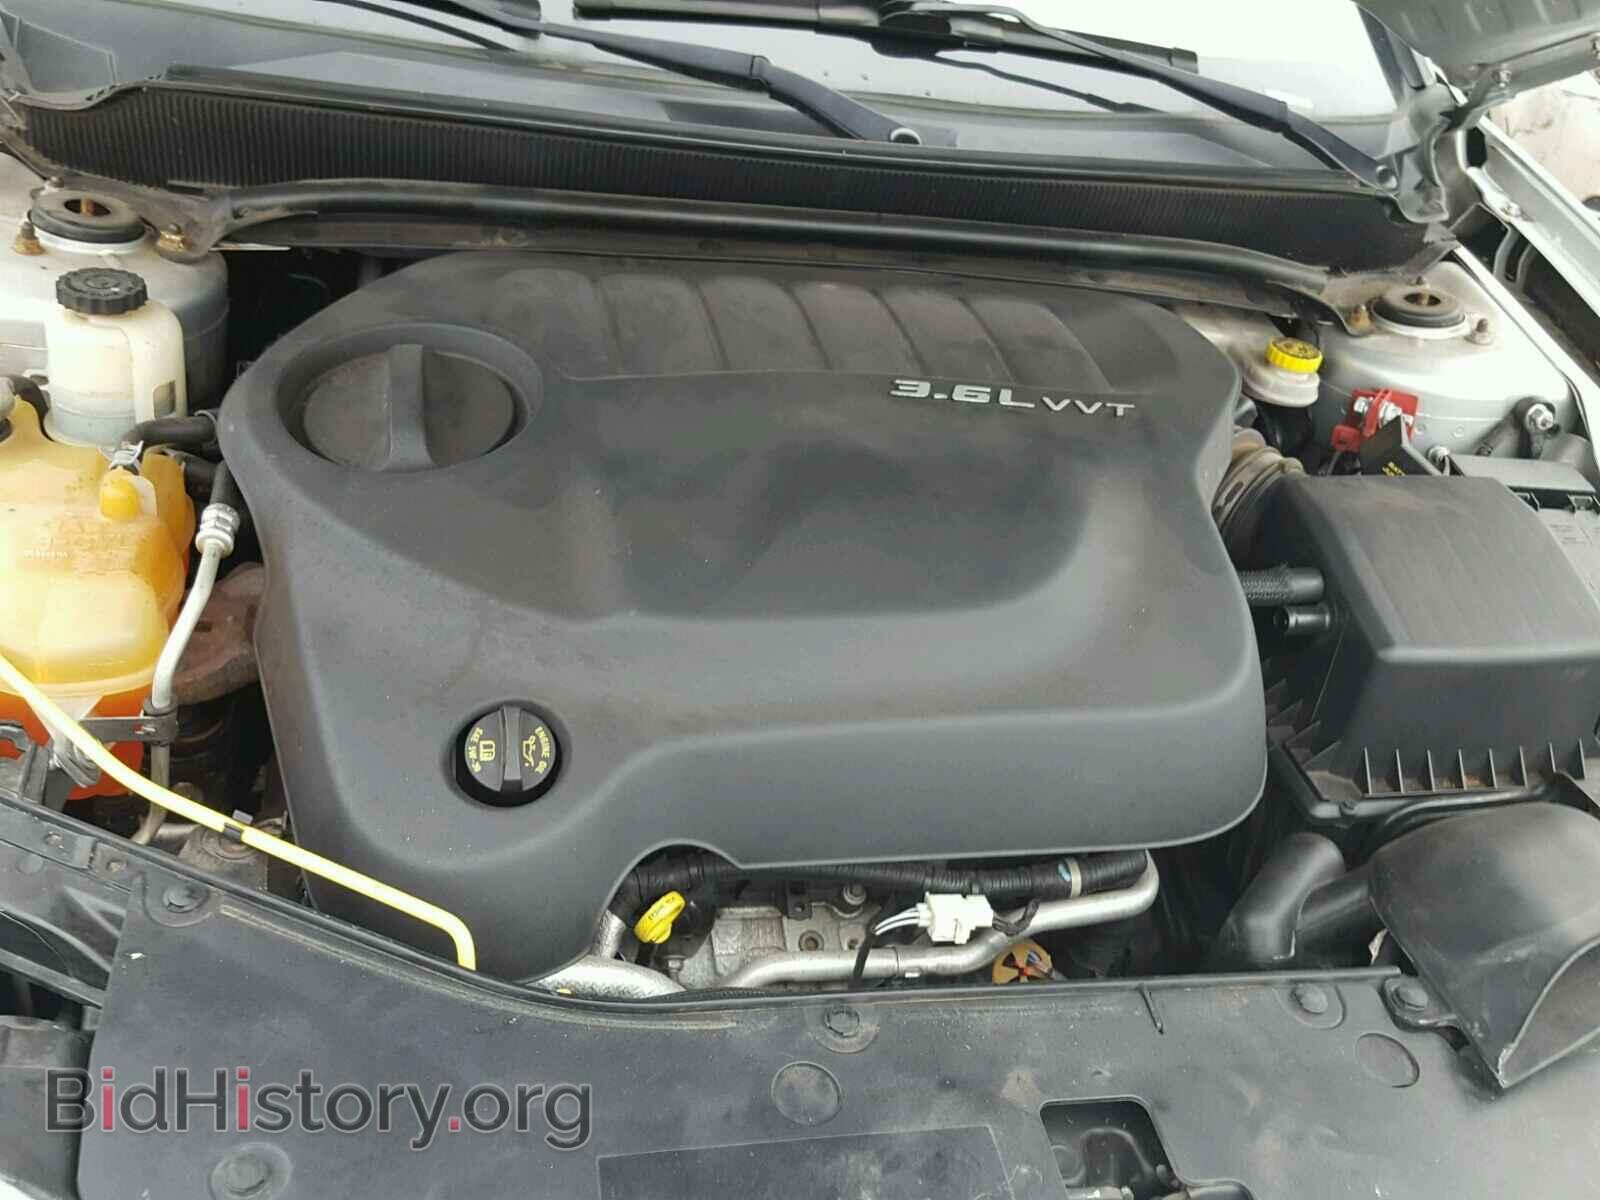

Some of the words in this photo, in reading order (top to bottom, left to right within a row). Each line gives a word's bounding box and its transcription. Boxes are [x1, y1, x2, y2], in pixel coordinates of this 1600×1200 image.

[889, 378, 1036, 409] 3.6L
[1041, 395, 1136, 417] VVT
[535, 726, 550, 758] ENGINE
